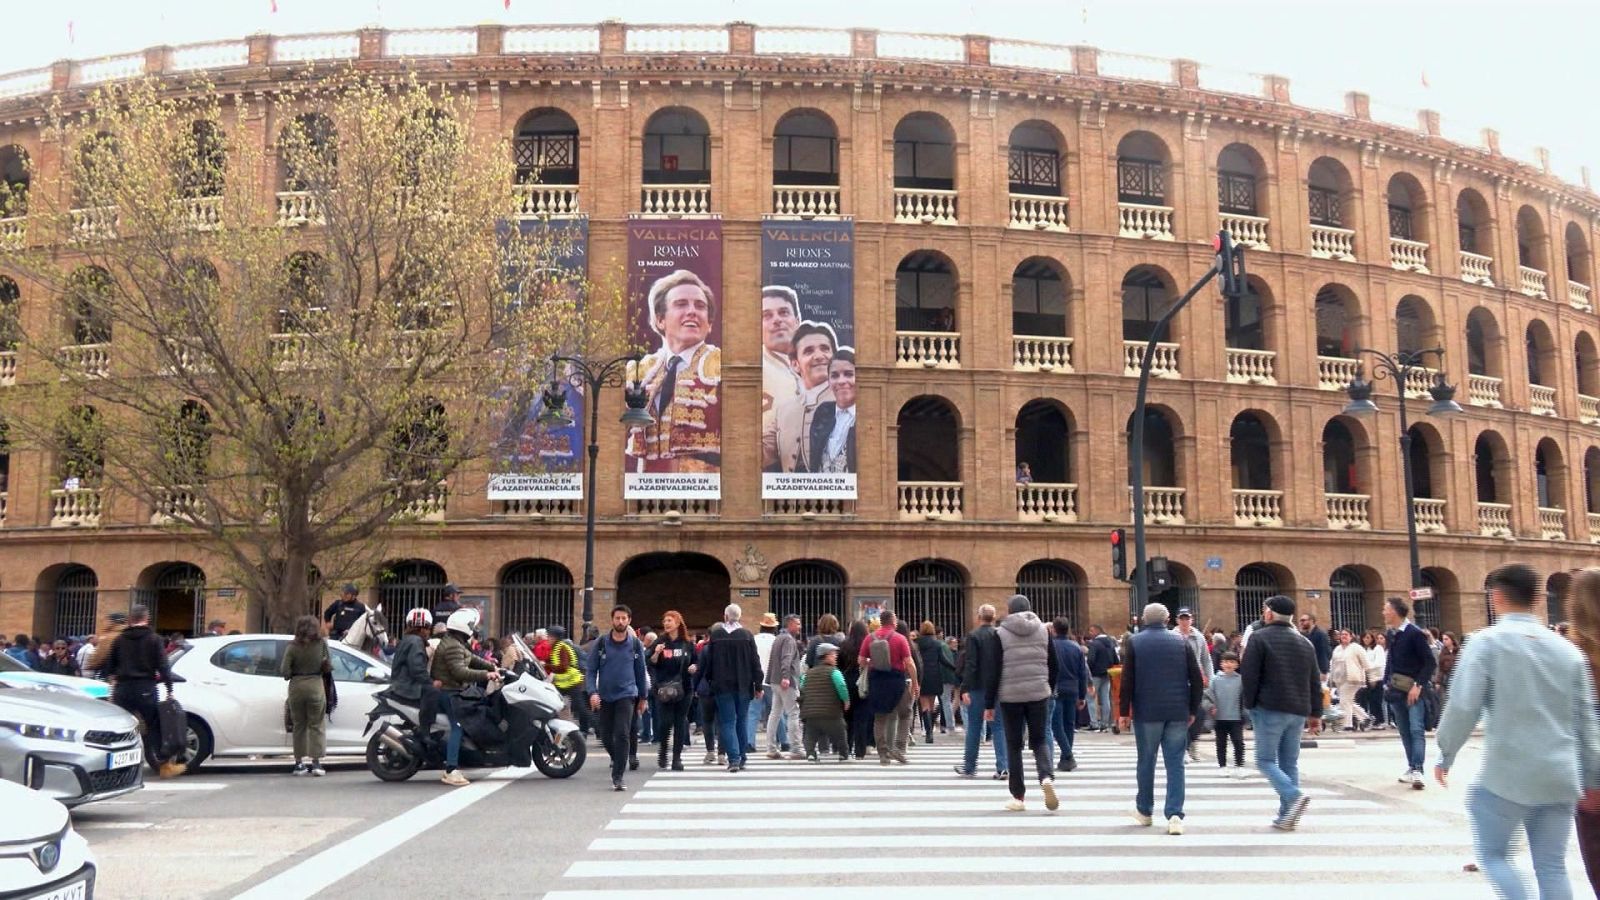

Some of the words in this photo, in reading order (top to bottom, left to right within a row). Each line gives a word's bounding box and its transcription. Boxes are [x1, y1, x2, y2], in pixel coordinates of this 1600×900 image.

[632, 229, 719, 241] VALENCIA
[767, 230, 850, 242] VALENCIA
[786, 247, 831, 258] REJONES
[791, 261, 819, 269] MARZO
[492, 484, 581, 492] PLAZADEVALENCIA.ES
[629, 484, 719, 492] PLAZADEVALENCIA.ES
[766, 484, 855, 492] PLAZADEVALENCIA.ES
